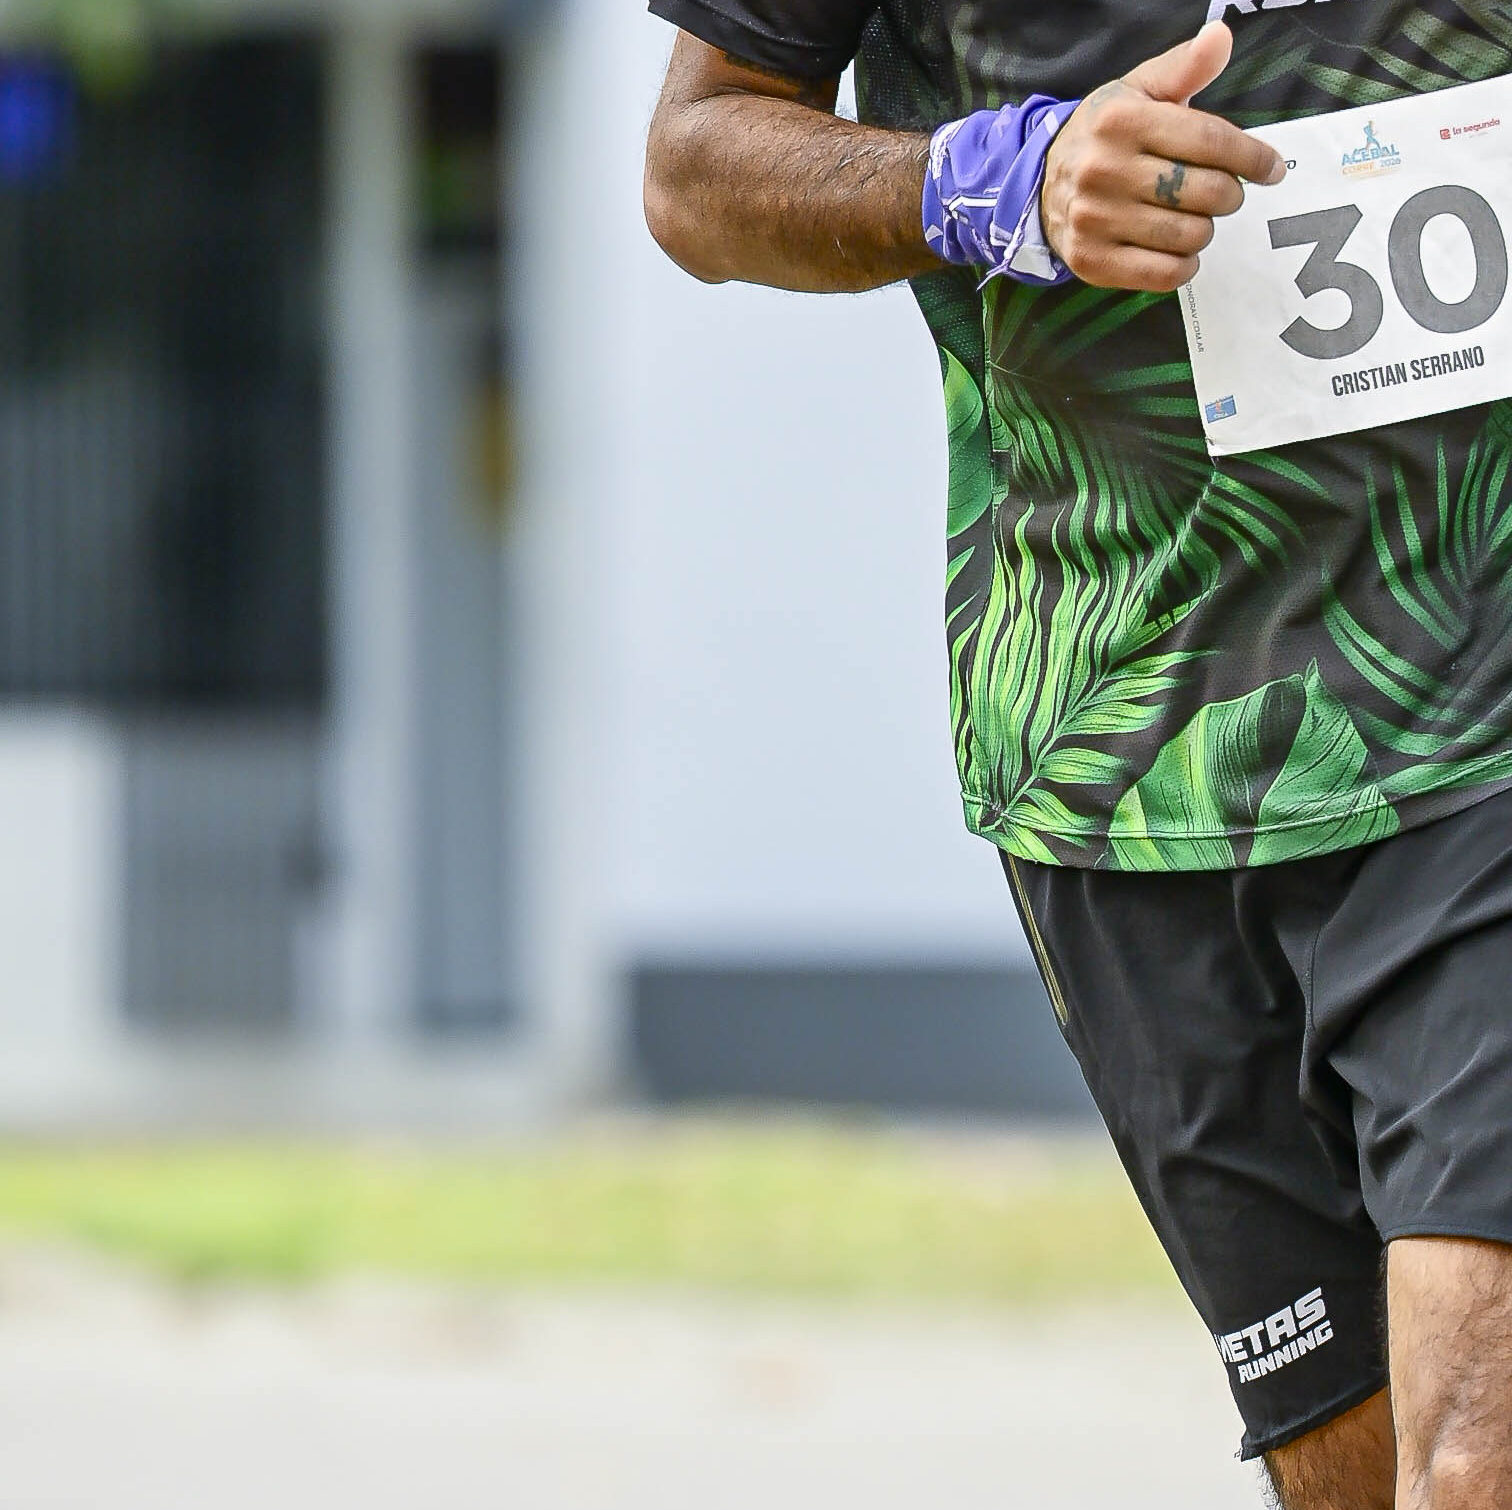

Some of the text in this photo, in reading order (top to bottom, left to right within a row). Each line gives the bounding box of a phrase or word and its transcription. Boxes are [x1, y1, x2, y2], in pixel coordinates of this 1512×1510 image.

[1463, 118, 1501, 133] segunda
[1342, 143, 1400, 166] ACEBAL
[1267, 184, 1509, 360] 30
[1331, 345, 1485, 397] CRISTIAN SERRANO
[1238, 1320, 1334, 1384] RUNNING
